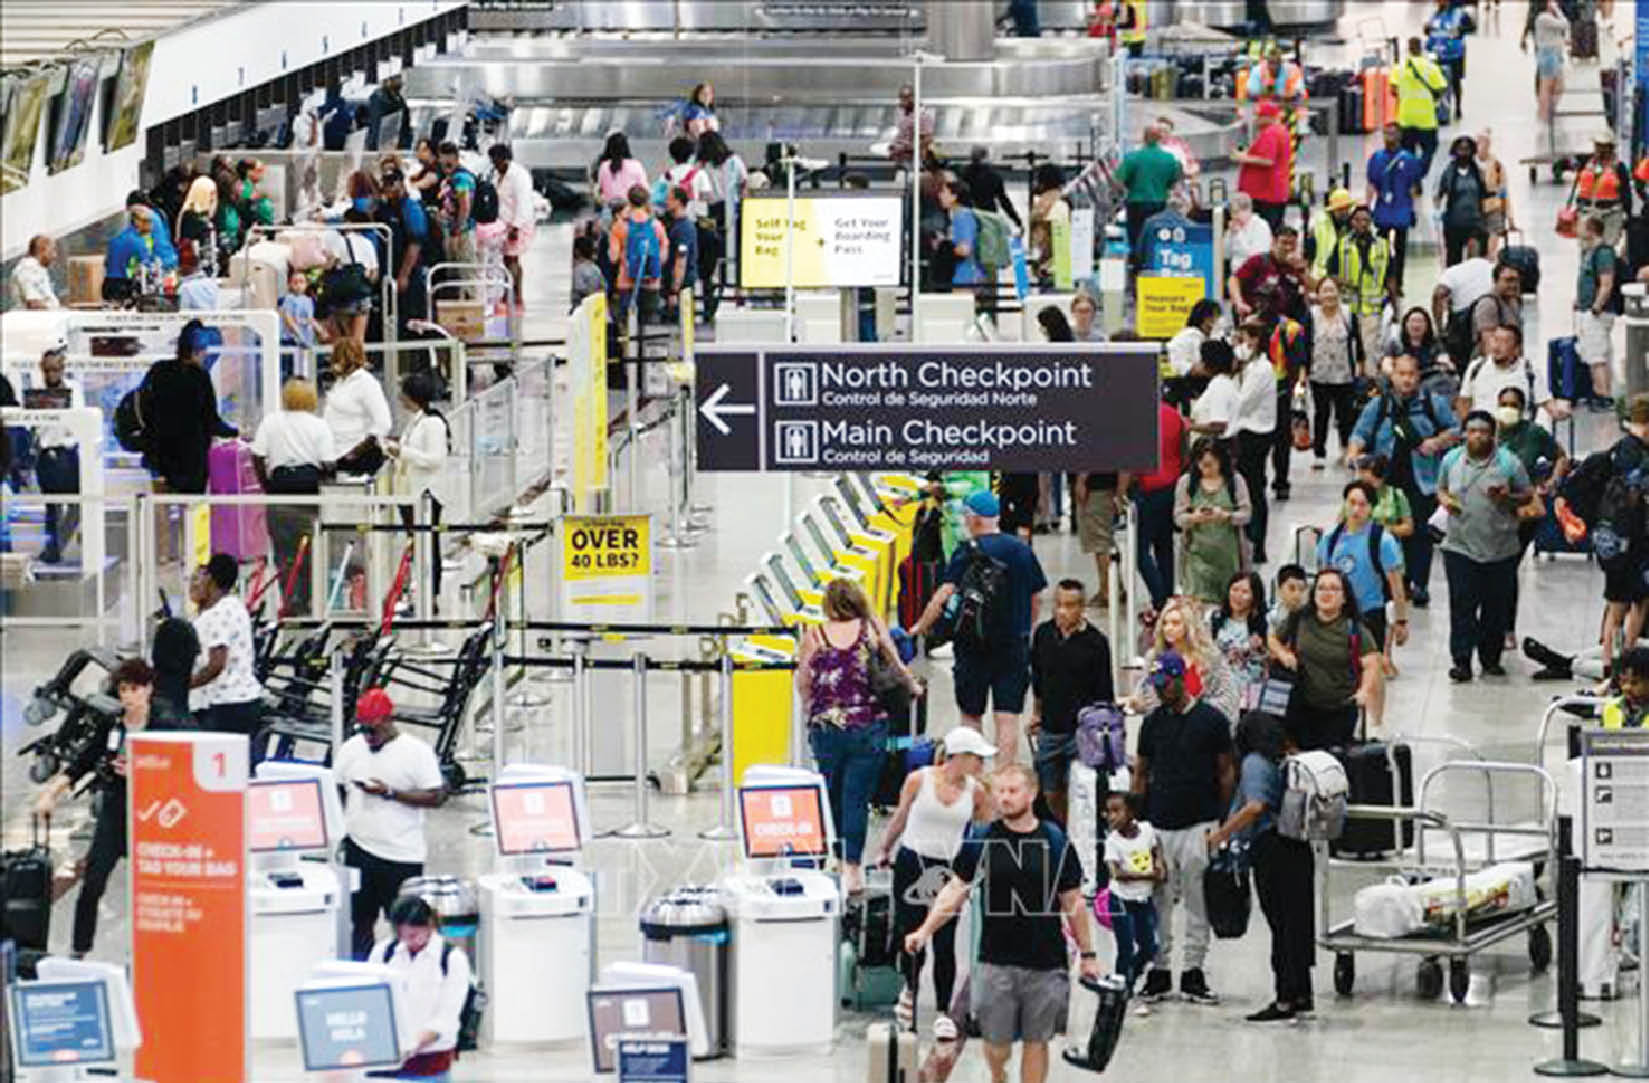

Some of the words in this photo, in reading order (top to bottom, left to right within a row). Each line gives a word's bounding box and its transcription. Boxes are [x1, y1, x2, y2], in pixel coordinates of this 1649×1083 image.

[755, 219, 781, 229] Self
[834, 218, 856, 228] Get
[861, 218, 888, 228] Your
[755, 232, 783, 241] Your
[834, 231, 891, 242] Boarding
[755, 246, 779, 257] Bag
[1161, 248, 1192, 270] Tag
[822, 363, 908, 387] North
[918, 362, 1092, 391] Checkpoint
[822, 391, 882, 405] Control
[885, 391, 905, 405] de
[908, 391, 989, 408] Seguridad
[992, 391, 1038, 406] Norte
[822, 420, 893, 444] Main
[903, 420, 1077, 449] Checkpoint
[822, 449, 882, 463] Control
[885, 449, 906, 463] de
[908, 449, 990, 465] Seguridad
[571, 528, 639, 550] OVER
[571, 554, 592, 567] 40
[596, 552, 639, 567] LBS?
[211, 752, 225, 777] 1
[165, 861, 201, 875] YOUR
